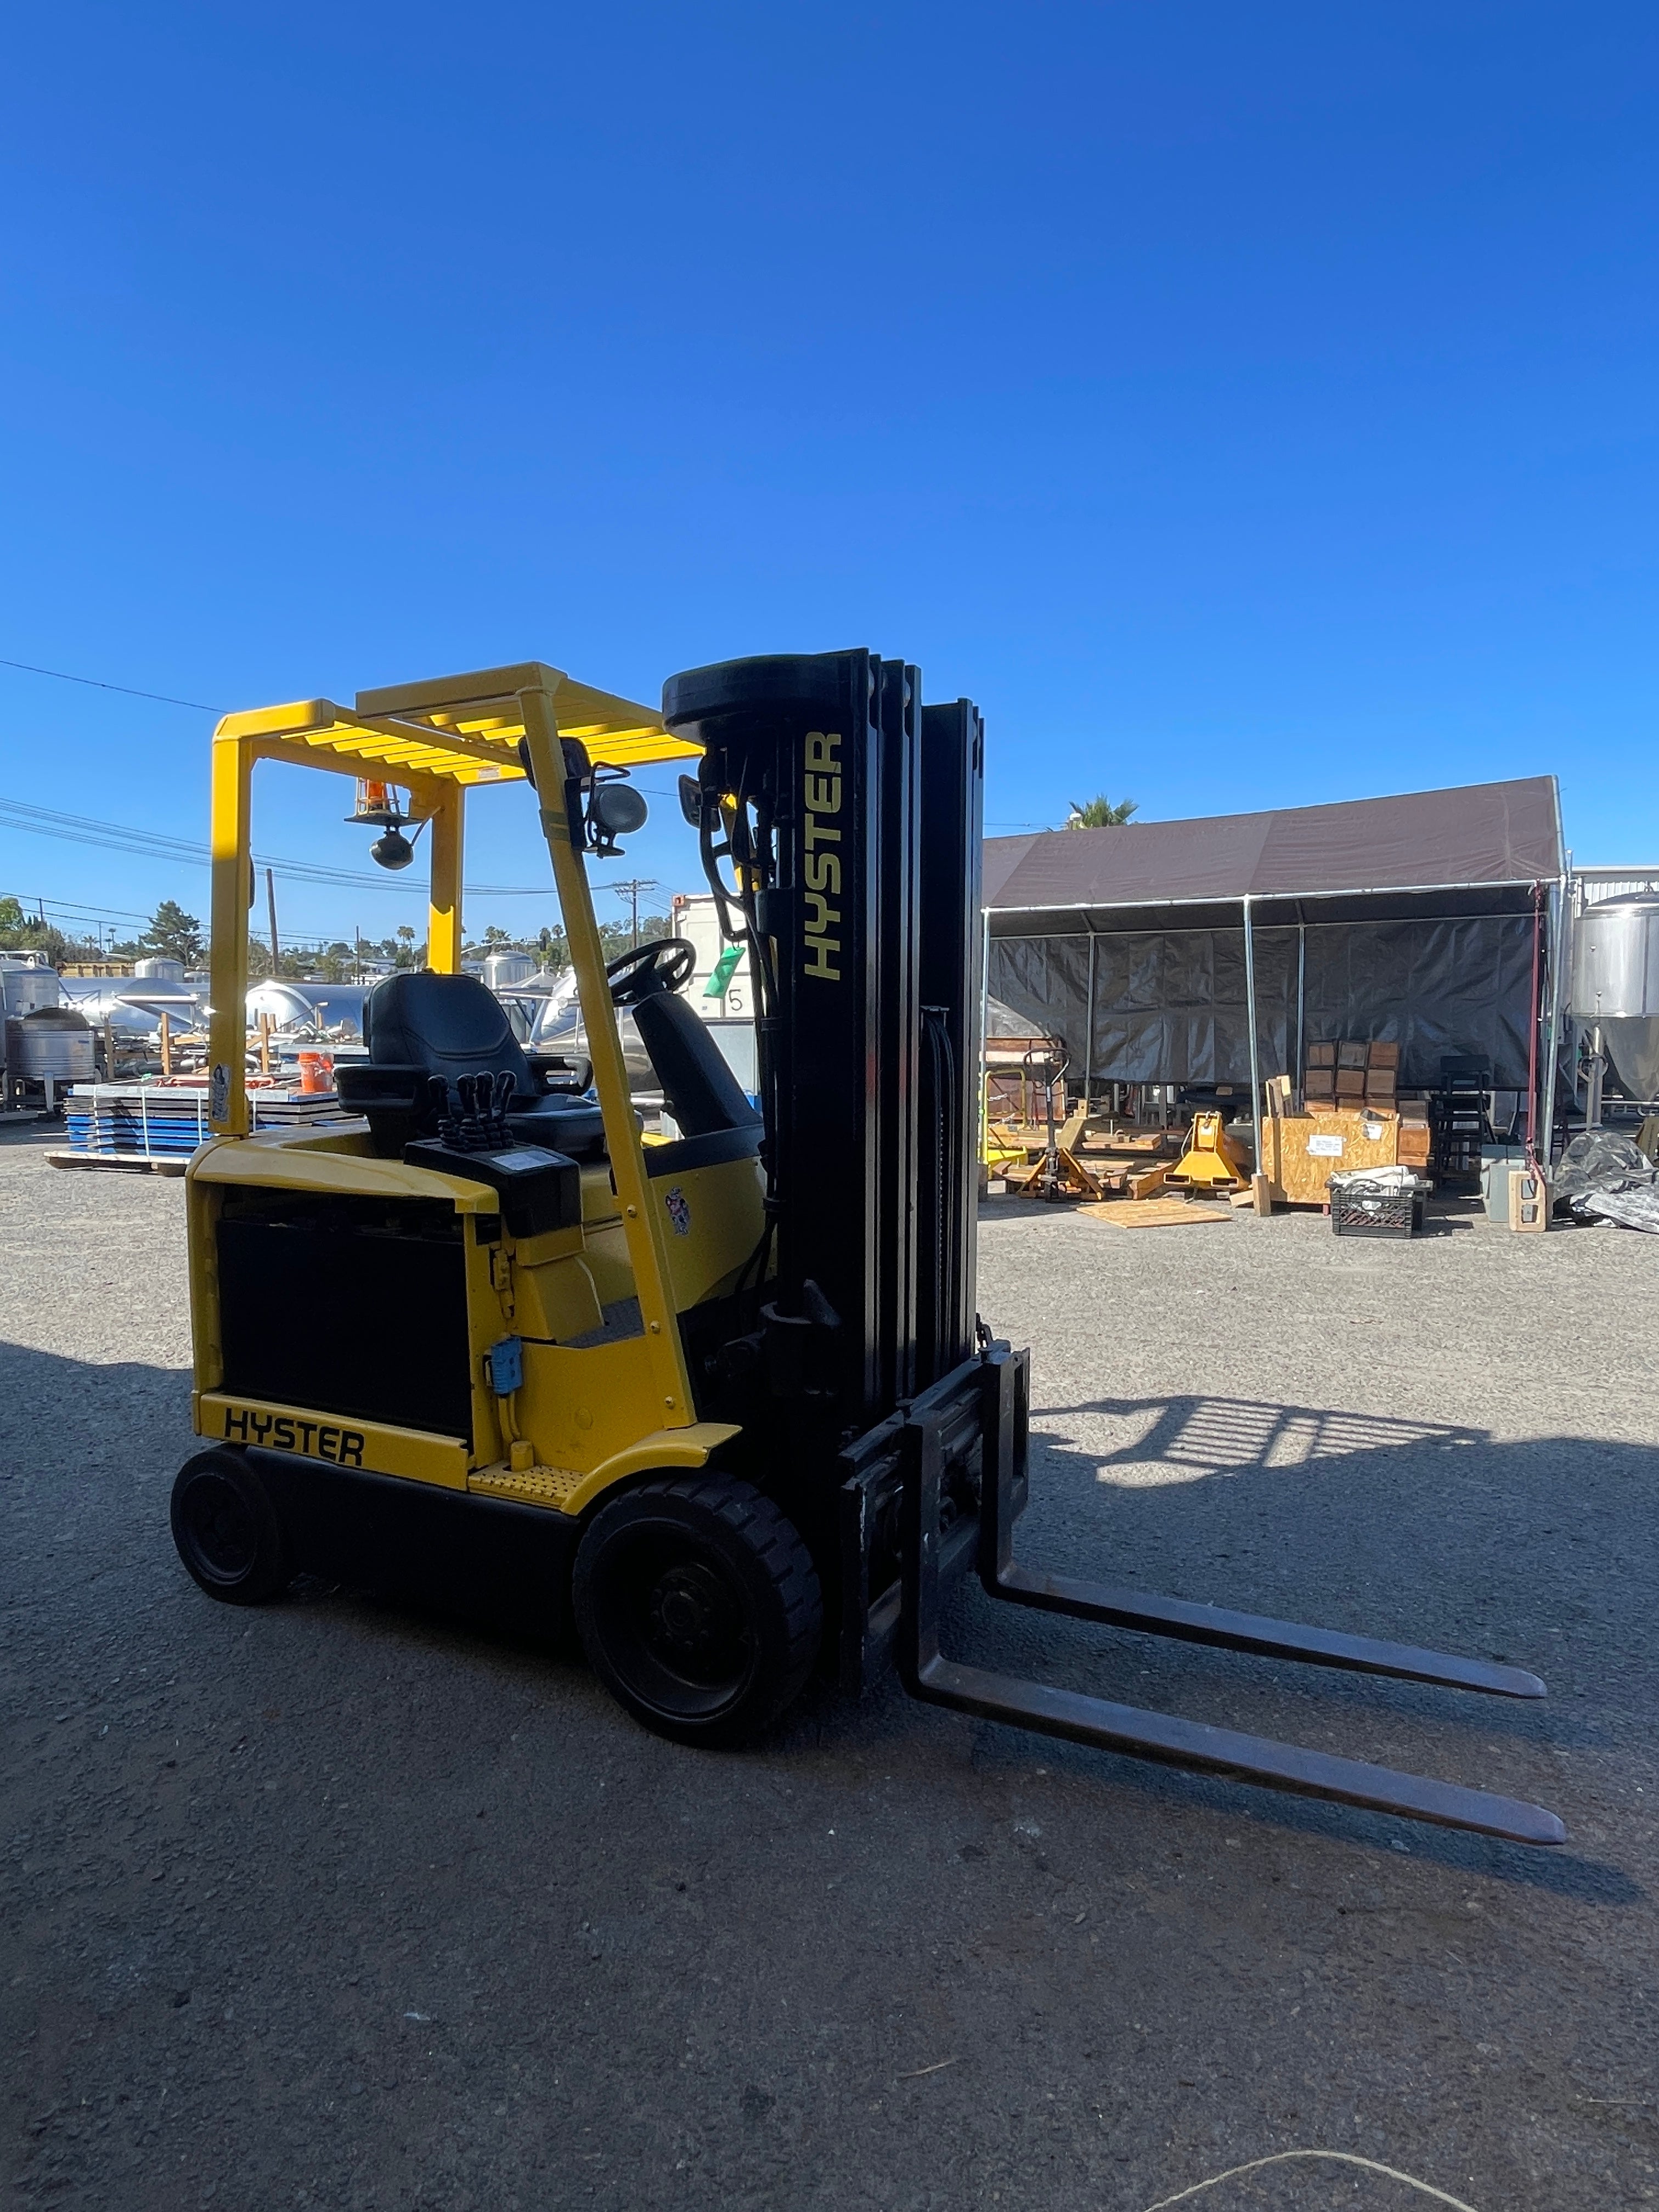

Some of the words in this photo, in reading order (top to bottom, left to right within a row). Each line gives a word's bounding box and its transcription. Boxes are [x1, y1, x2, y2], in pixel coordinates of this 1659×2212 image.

[805, 732, 841, 980] HYSTER
[729, 989, 743, 1011] 5
[224, 1408, 364, 1466] HYSTER
